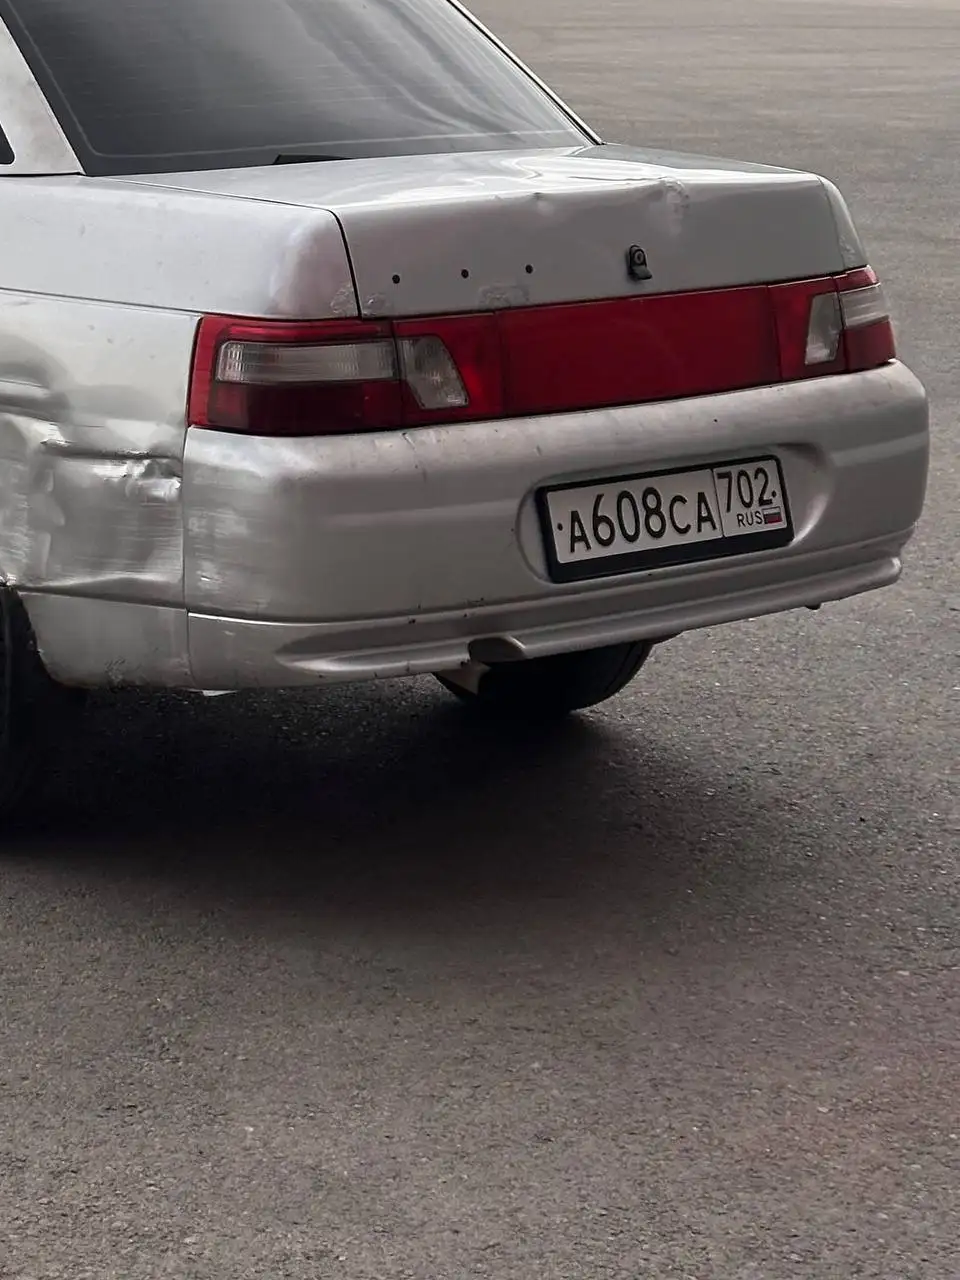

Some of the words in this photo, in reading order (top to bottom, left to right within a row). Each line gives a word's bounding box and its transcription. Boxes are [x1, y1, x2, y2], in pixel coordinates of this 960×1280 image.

[570, 487, 718, 553] А608СА
[717, 467, 773, 513] 702
[736, 510, 763, 528] RUS
